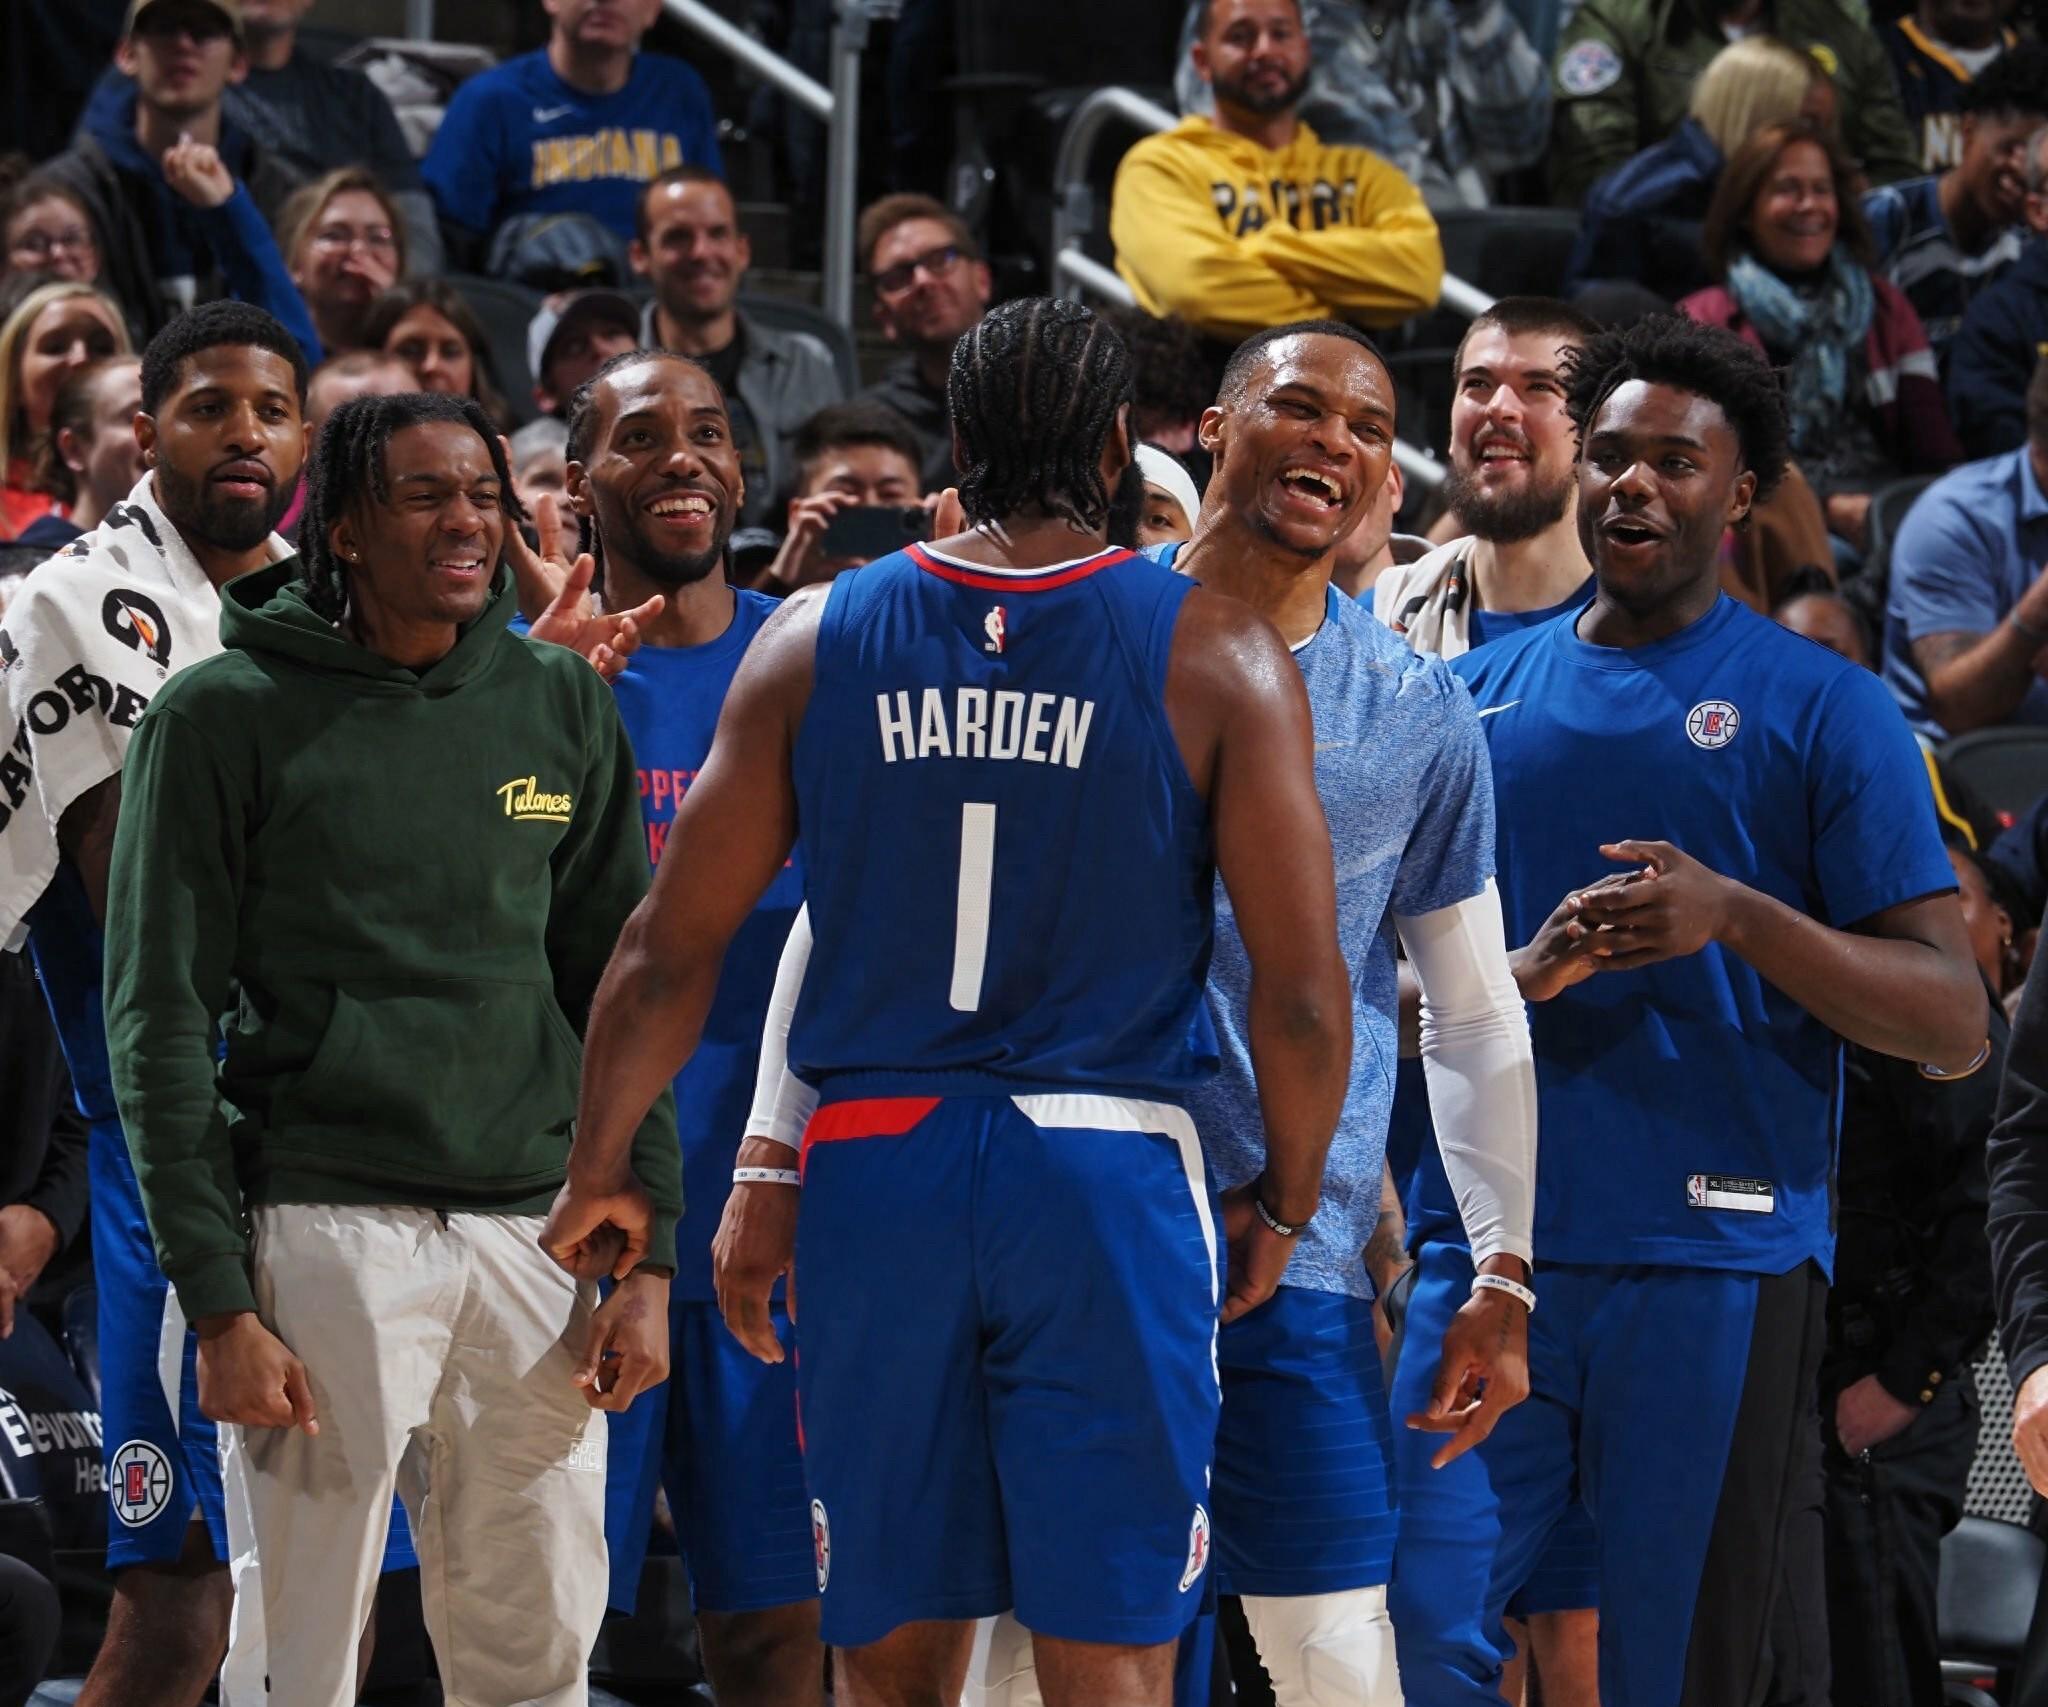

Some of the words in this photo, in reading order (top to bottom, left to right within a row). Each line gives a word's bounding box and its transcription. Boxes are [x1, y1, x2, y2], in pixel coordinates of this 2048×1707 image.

[532, 126, 683, 190] INDIANA
[876, 687, 1095, 769] HARDEN
[949, 802, 997, 1012] 1
